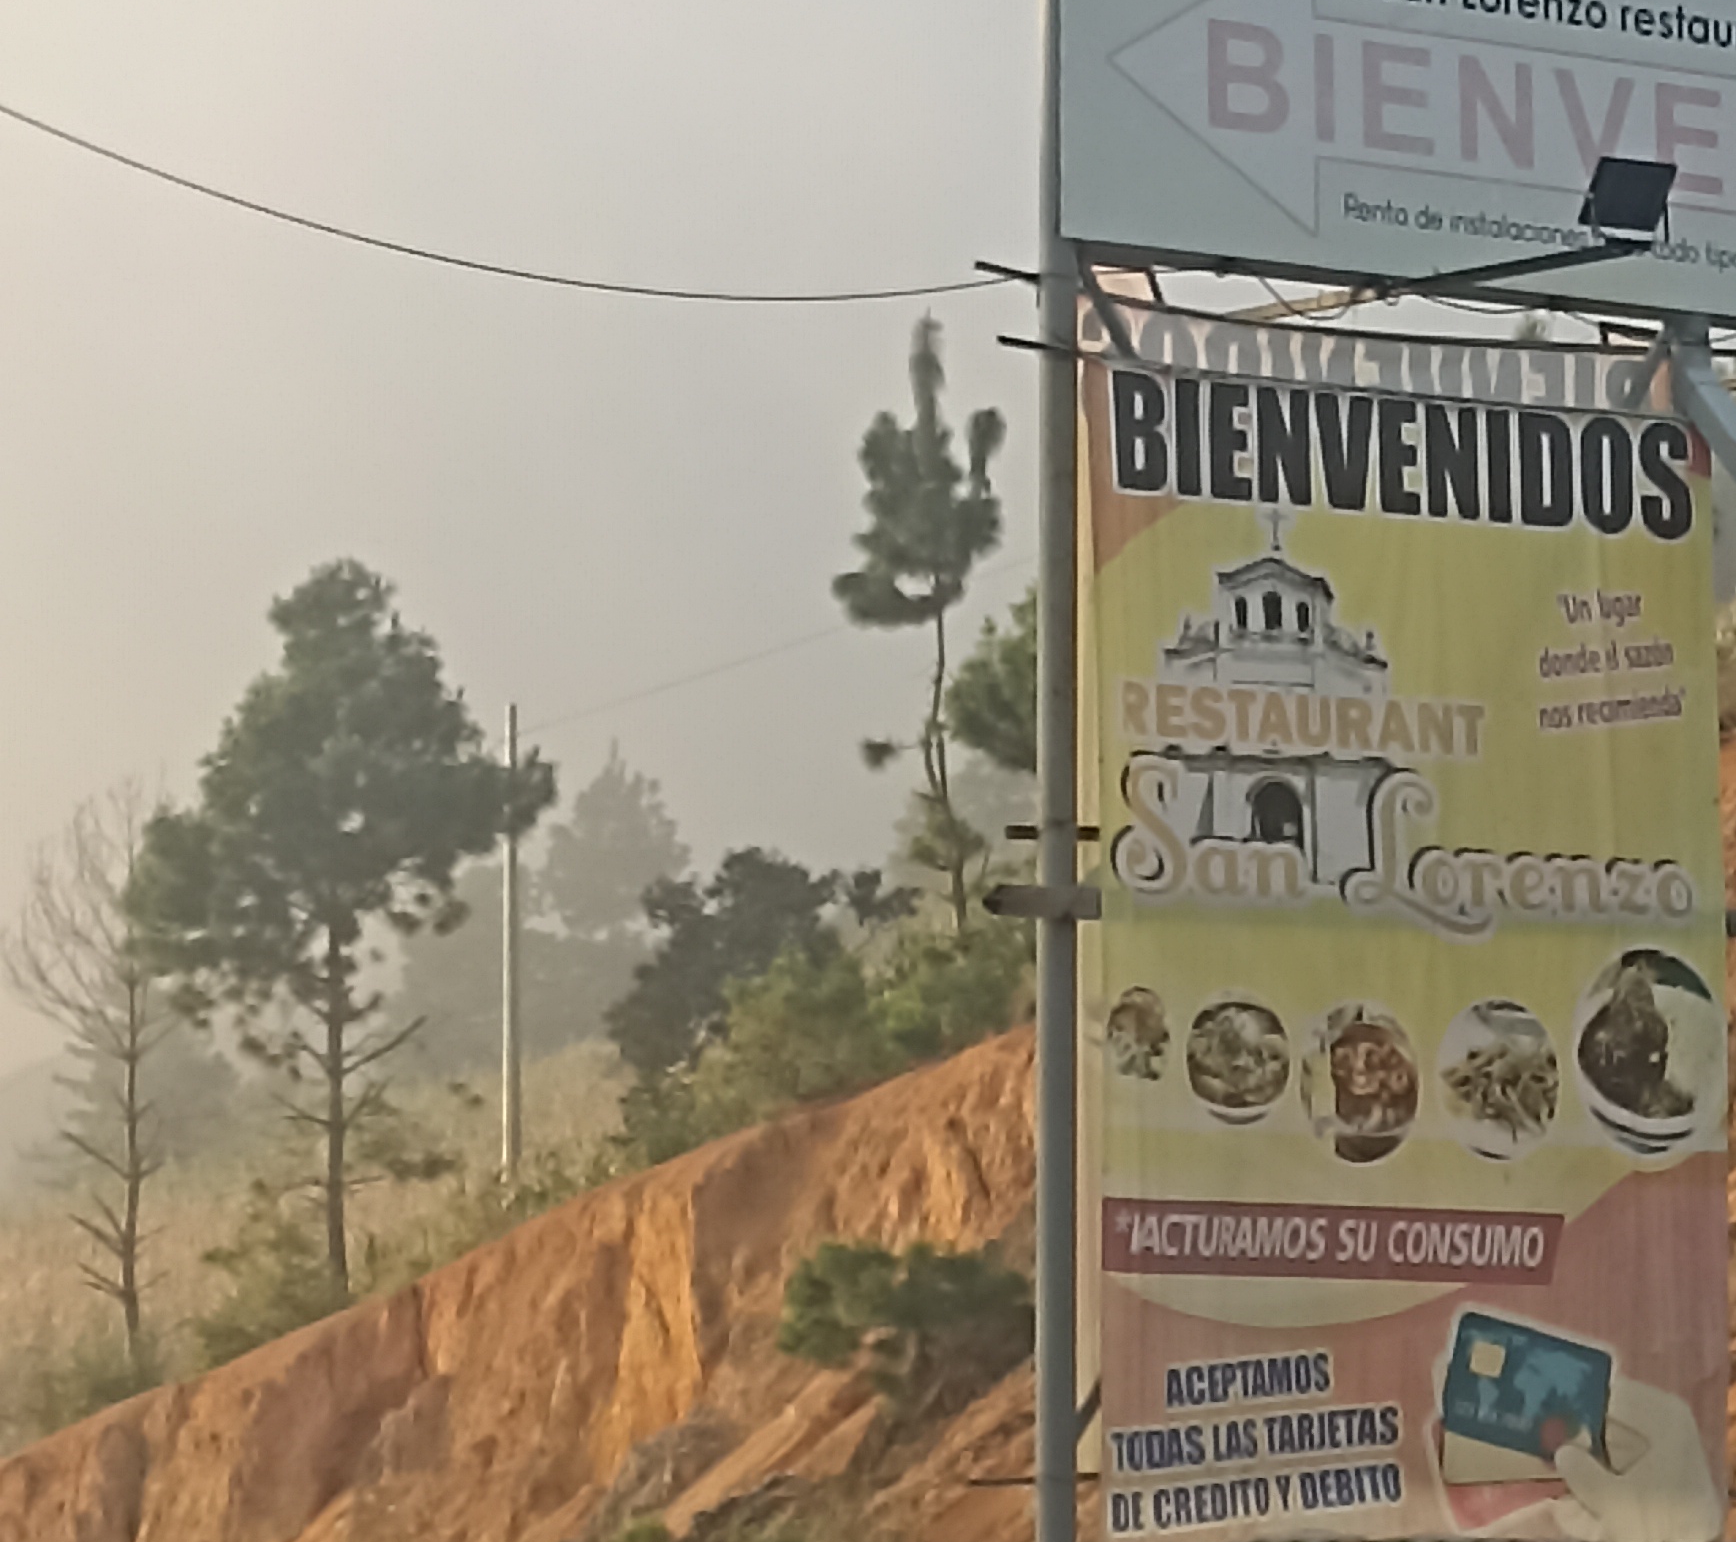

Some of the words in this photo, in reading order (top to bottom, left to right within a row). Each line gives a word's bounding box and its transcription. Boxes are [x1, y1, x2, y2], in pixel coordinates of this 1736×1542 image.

[1343, 192, 1408, 226] Renta
[1414, 205, 1443, 231] de
[1113, 369, 1694, 540] BIENVENIDOS
[1122, 680, 1486, 756] RESTAURANT
[1110, 755, 1303, 896] San
[1339, 766, 1693, 936] Lorenzo
[1335, 1218, 1378, 1262] SU
[1388, 1221, 1545, 1268] CONSUMO
[1166, 1352, 1331, 1407] ACEPTAMOS
[1110, 1425, 1206, 1473] TODAS
[1212, 1418, 1258, 1463] LAS
[1263, 1406, 1400, 1456] TARJETAS
[1111, 1491, 1145, 1533] DE
[1153, 1477, 1270, 1530] CREDITO
[1275, 1474, 1291, 1511] Y
[1300, 1463, 1403, 1510] DEBITO
